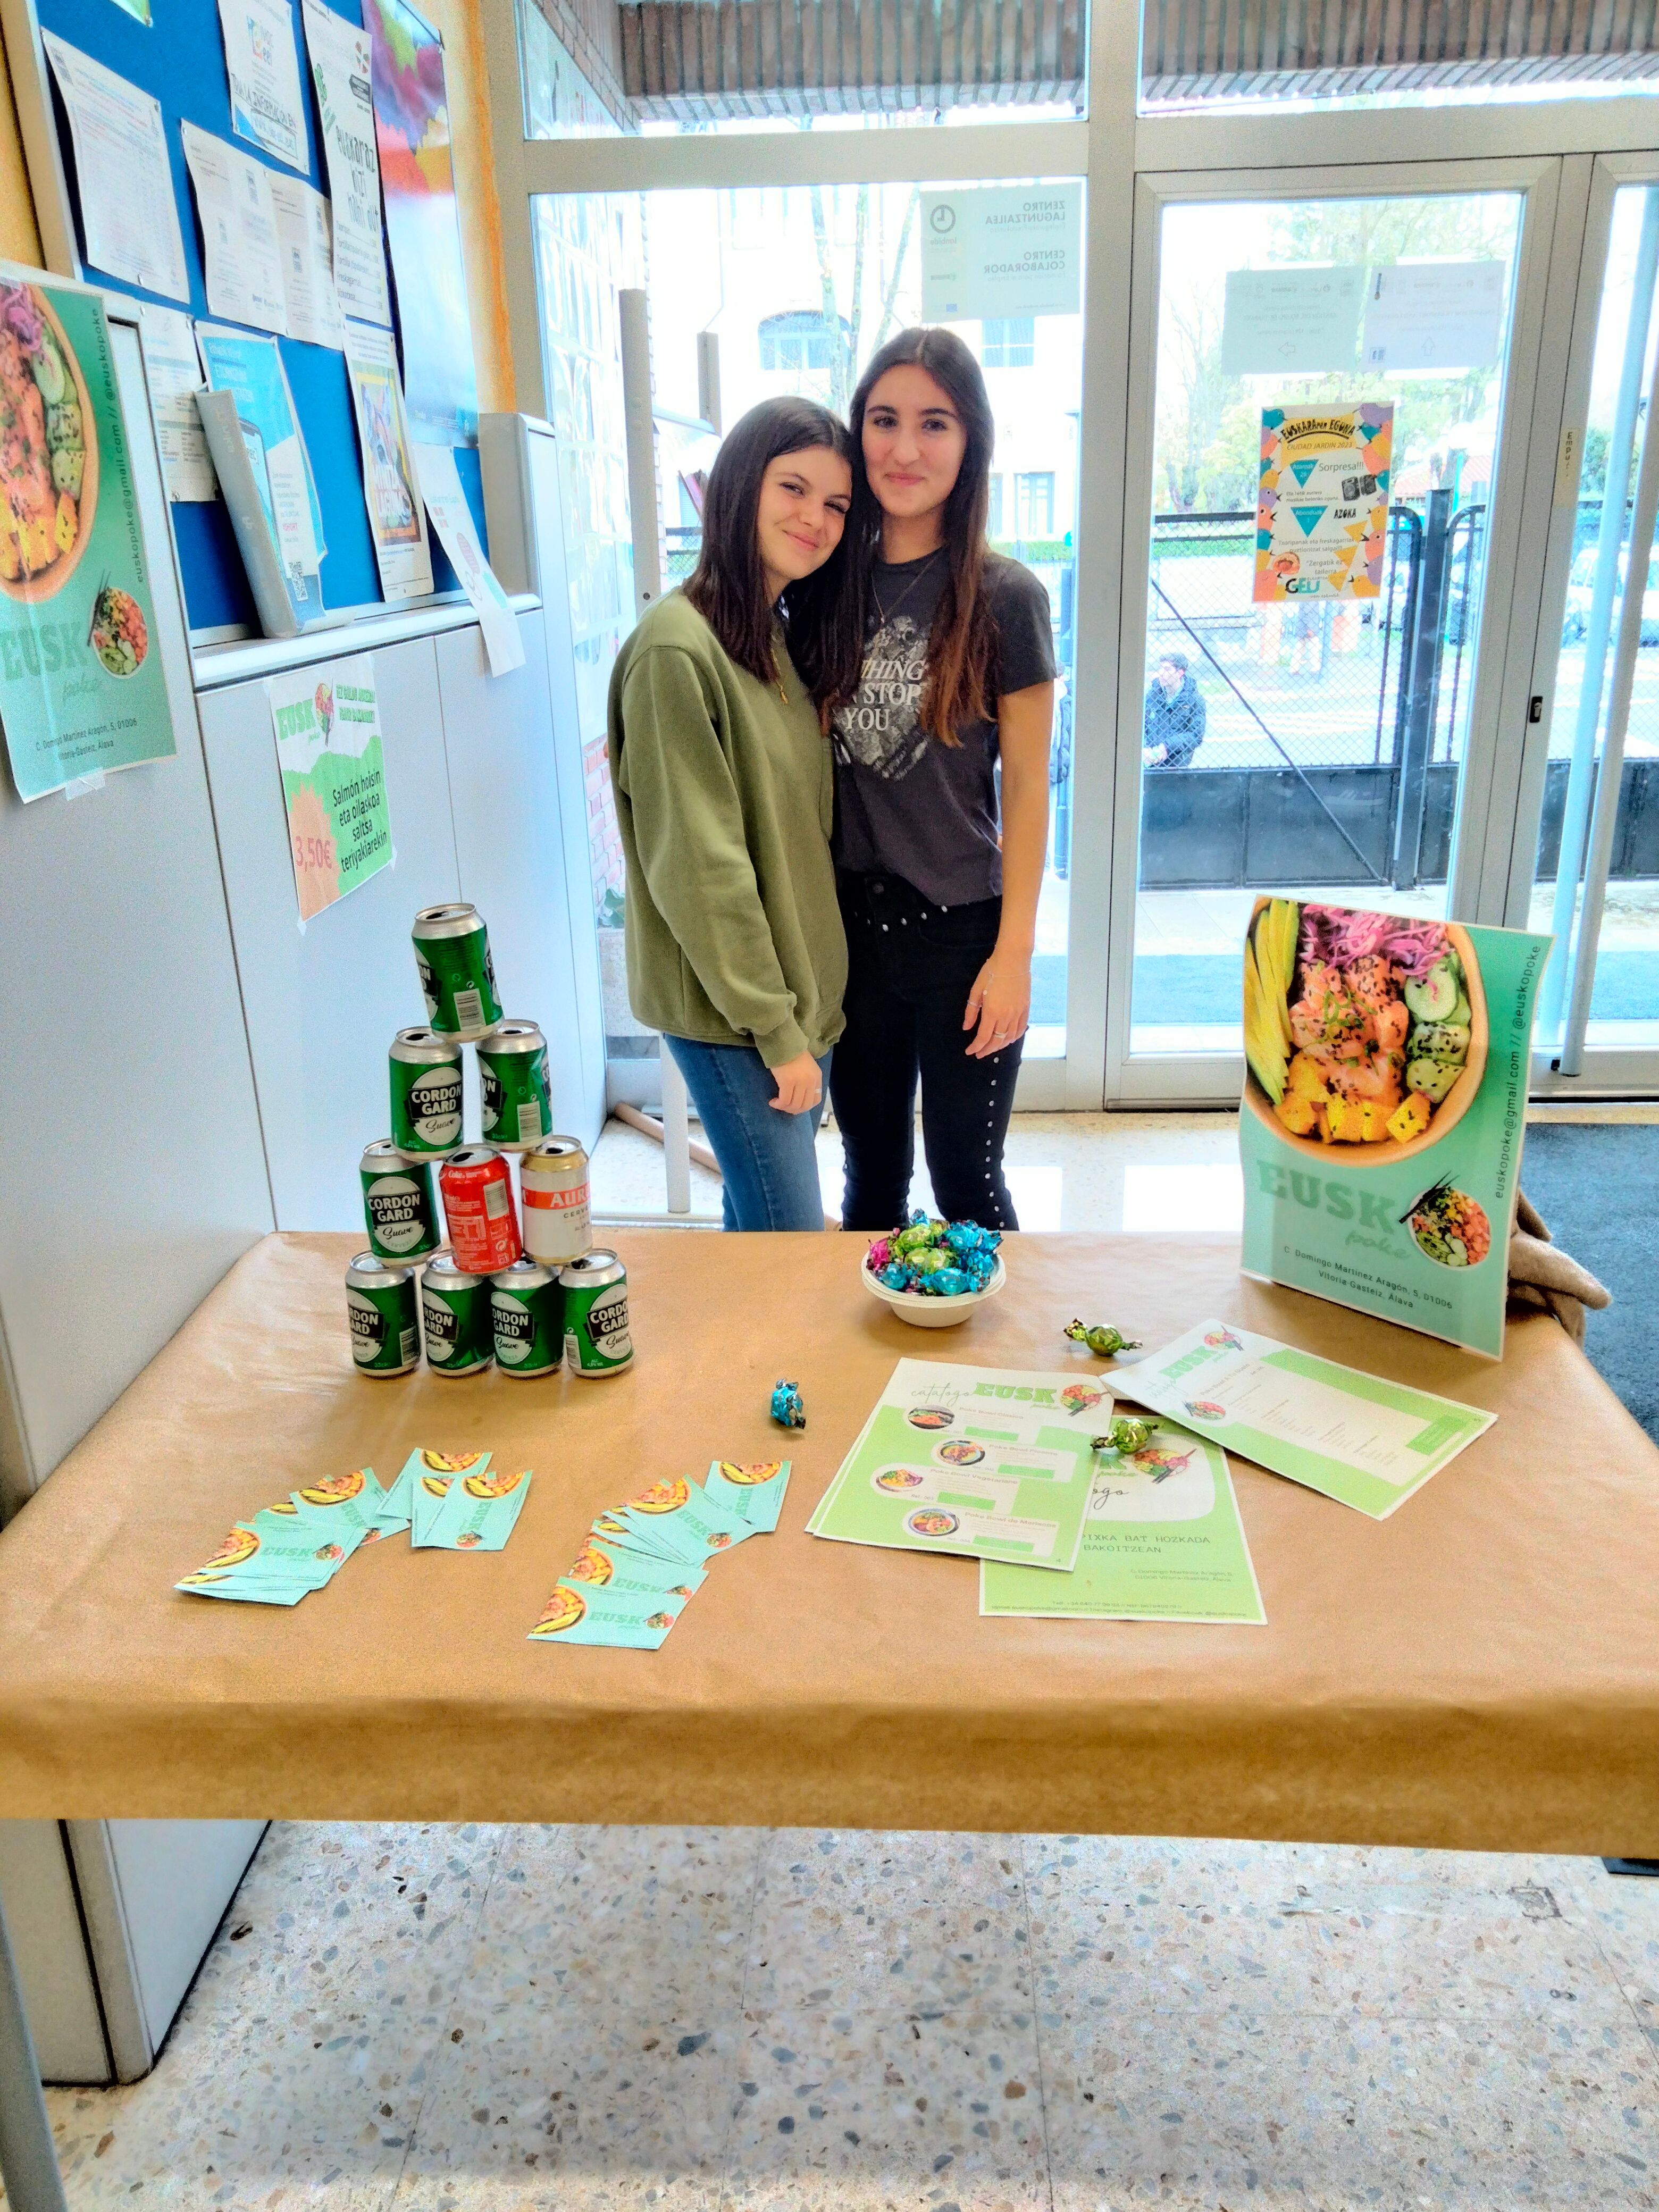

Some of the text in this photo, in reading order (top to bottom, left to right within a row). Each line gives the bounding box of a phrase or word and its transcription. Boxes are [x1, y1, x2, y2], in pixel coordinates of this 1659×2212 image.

[92, 308, 116, 401] @euskopoke
[1329, 420, 1355, 436] EGUNA
[1287, 442, 1312, 451] CIUDAD
[1319, 461, 1364, 473] Sorpresa!!!
[114, 423, 144, 583] euskopoke@gmail.com
[1334, 508, 1356, 519] AZOKA
[1285, 577, 1320, 594] GEU
[864, 682, 922, 706] STOP
[118, 718, 137, 730] 01006
[275, 698, 316, 741] EUSK
[844, 707, 890, 731] YOU
[332, 768, 381, 807] Salmón hoisin
[339, 792, 380, 827] eta oilaskoa
[352, 819, 373, 842] saltsa
[296, 835, 332, 873] 3,50€
[341, 829, 387, 873] teriyakiarekin
[1496, 1051, 1520, 1200] euskopoke@gmail.com
[1514, 945, 1541, 1030] @euskopoke
[411, 1084, 462, 1103] CORDON
[422, 1099, 456, 1115] GARD
[425, 1118, 455, 1133] Suave
[368, 1194, 420, 1211] CORDON
[1257, 1159, 1395, 1235] EUSK
[377, 1208, 414, 1222] GARD
[383, 1226, 414, 1240] Suave
[1345, 1230, 1411, 1259] poke
[1295, 1249, 1332, 1269] Domingo
[1423, 1292, 1453, 1310] 01006
[1388, 1289, 1414, 1308] Álava
[349, 1307, 379, 1325] RDON
[425, 1306, 453, 1327] RDON
[492, 1308, 528, 1326] ORDON
[590, 1301, 627, 1323] CORDO
[350, 1320, 370, 1335] ARD
[425, 1320, 443, 1335] ARD
[494, 1320, 520, 1336] GARD
[601, 1312, 629, 1333] GARD
[496, 1336, 519, 1350] Suave
[606, 1331, 629, 1349] Suav
[1158, 1345, 1218, 1379] EUSK
[911, 1382, 1057, 1406] catalogo EUSK
[972, 1473, 1019, 1485] Vegetariano
[986, 1514, 1007, 1523] Bowl
[1084, 1544, 1161, 1554] BAKOITZEAN
[589, 1611, 645, 1625] EUSK
